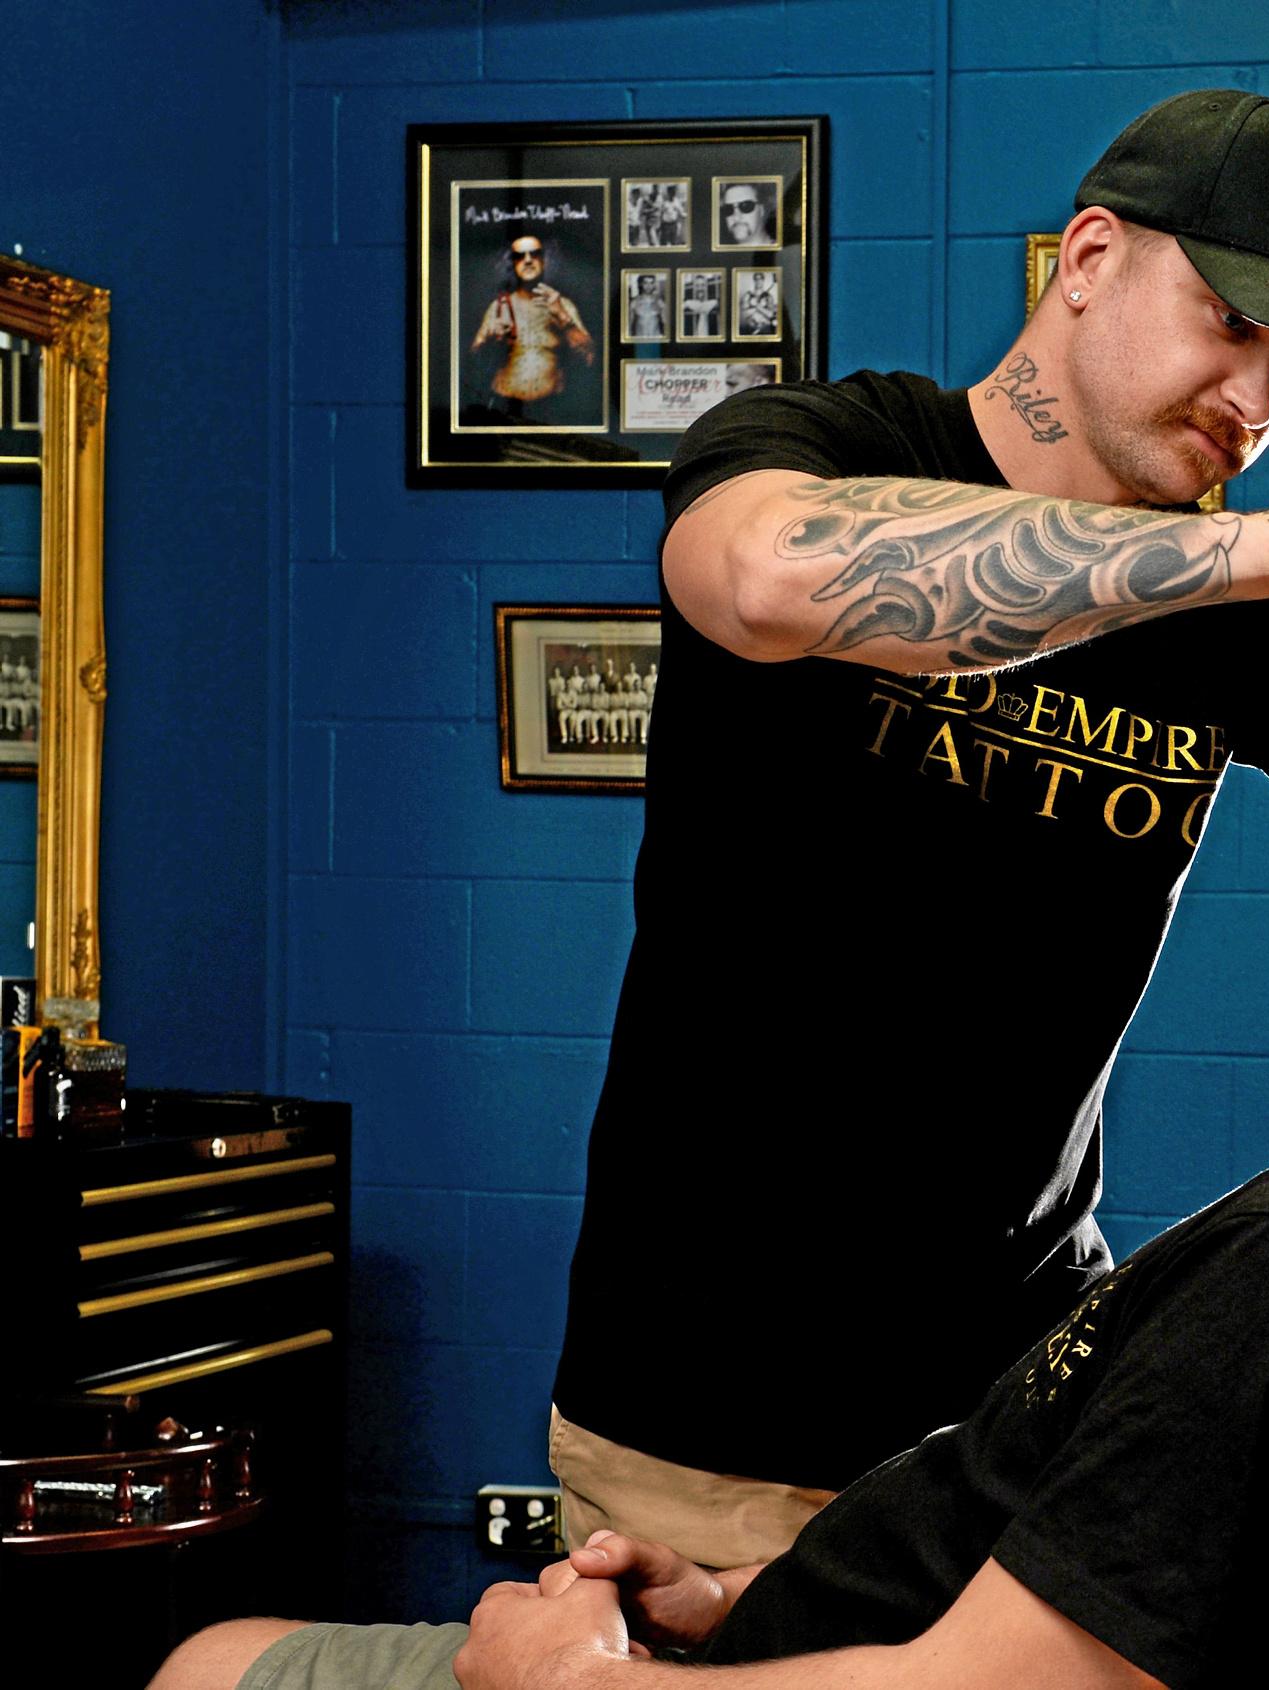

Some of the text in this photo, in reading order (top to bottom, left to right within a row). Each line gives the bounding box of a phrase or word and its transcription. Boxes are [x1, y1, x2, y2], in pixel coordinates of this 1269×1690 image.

[668, 366, 718, 376] Brandon
[644, 379, 708, 390] CHOPPER
[985, 352, 1069, 444] Riley
